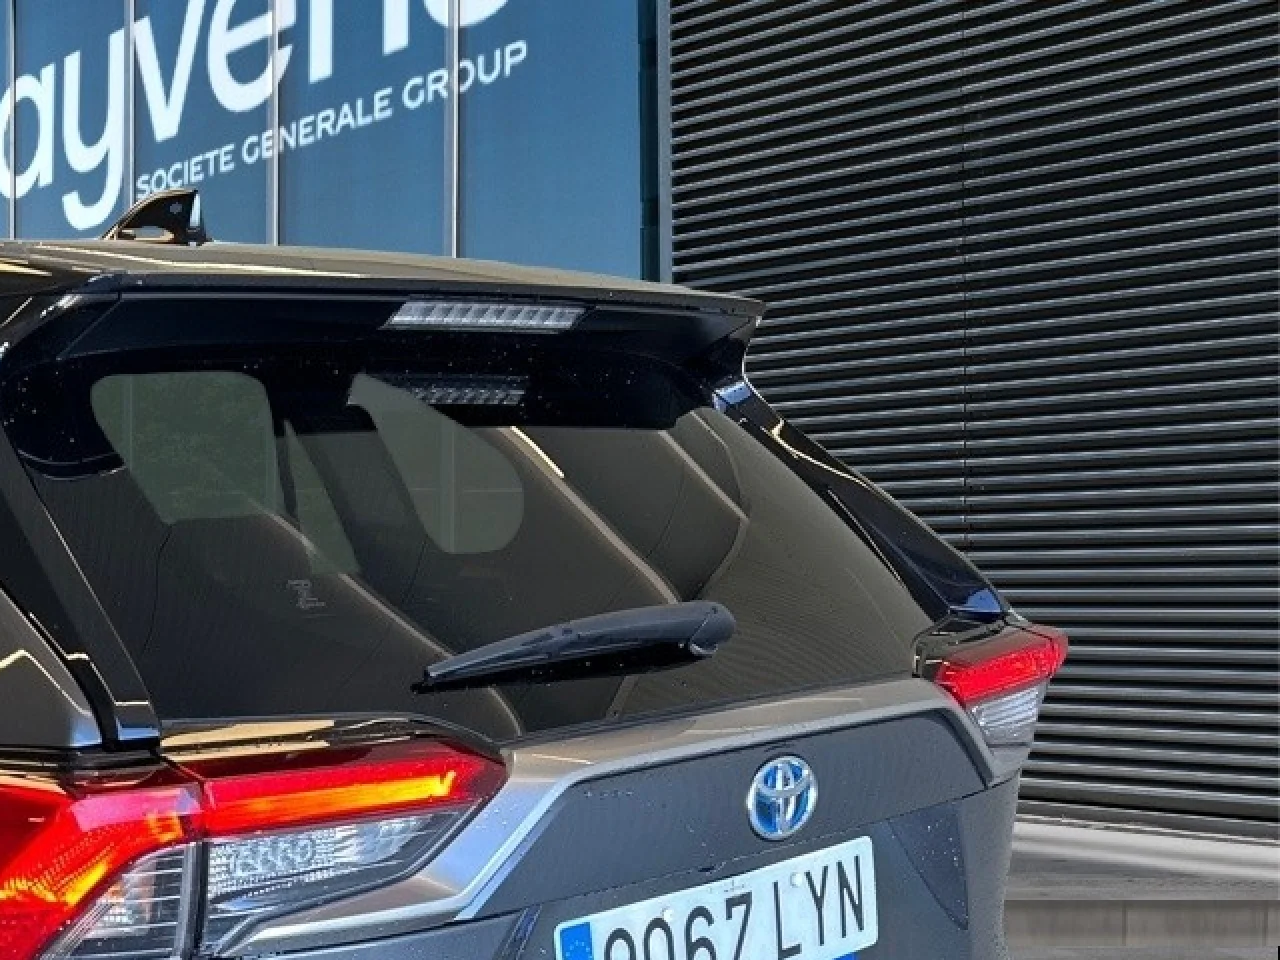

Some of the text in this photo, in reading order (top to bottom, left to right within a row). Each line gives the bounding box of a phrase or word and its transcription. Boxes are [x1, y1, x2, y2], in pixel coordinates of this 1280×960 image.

[135, 39, 528, 198] SOCIETE GENERALE GROUP
